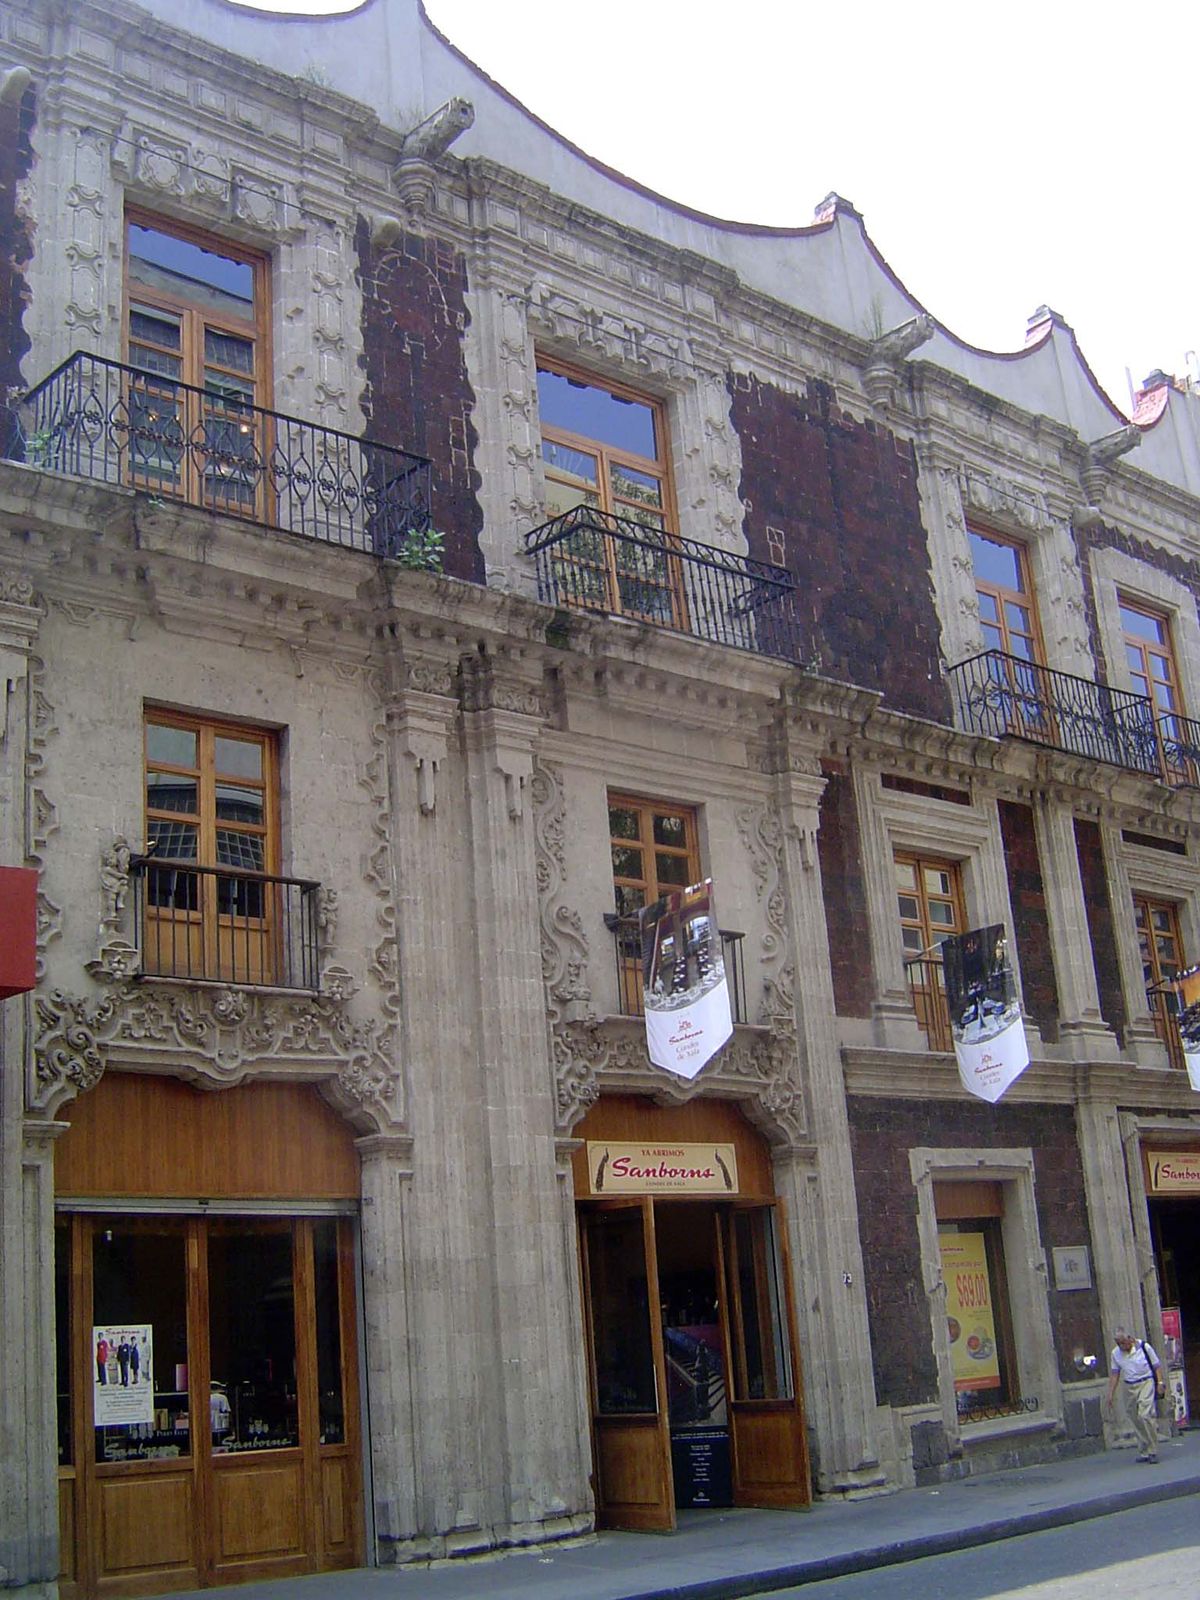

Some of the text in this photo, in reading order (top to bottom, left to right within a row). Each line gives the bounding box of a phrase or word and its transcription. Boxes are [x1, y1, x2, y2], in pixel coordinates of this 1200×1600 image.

[612, 1157, 715, 1178] Sanborns
[221, 1432, 292, 1449] Sanborns
[104, 1442, 181, 1458] Sanborns
